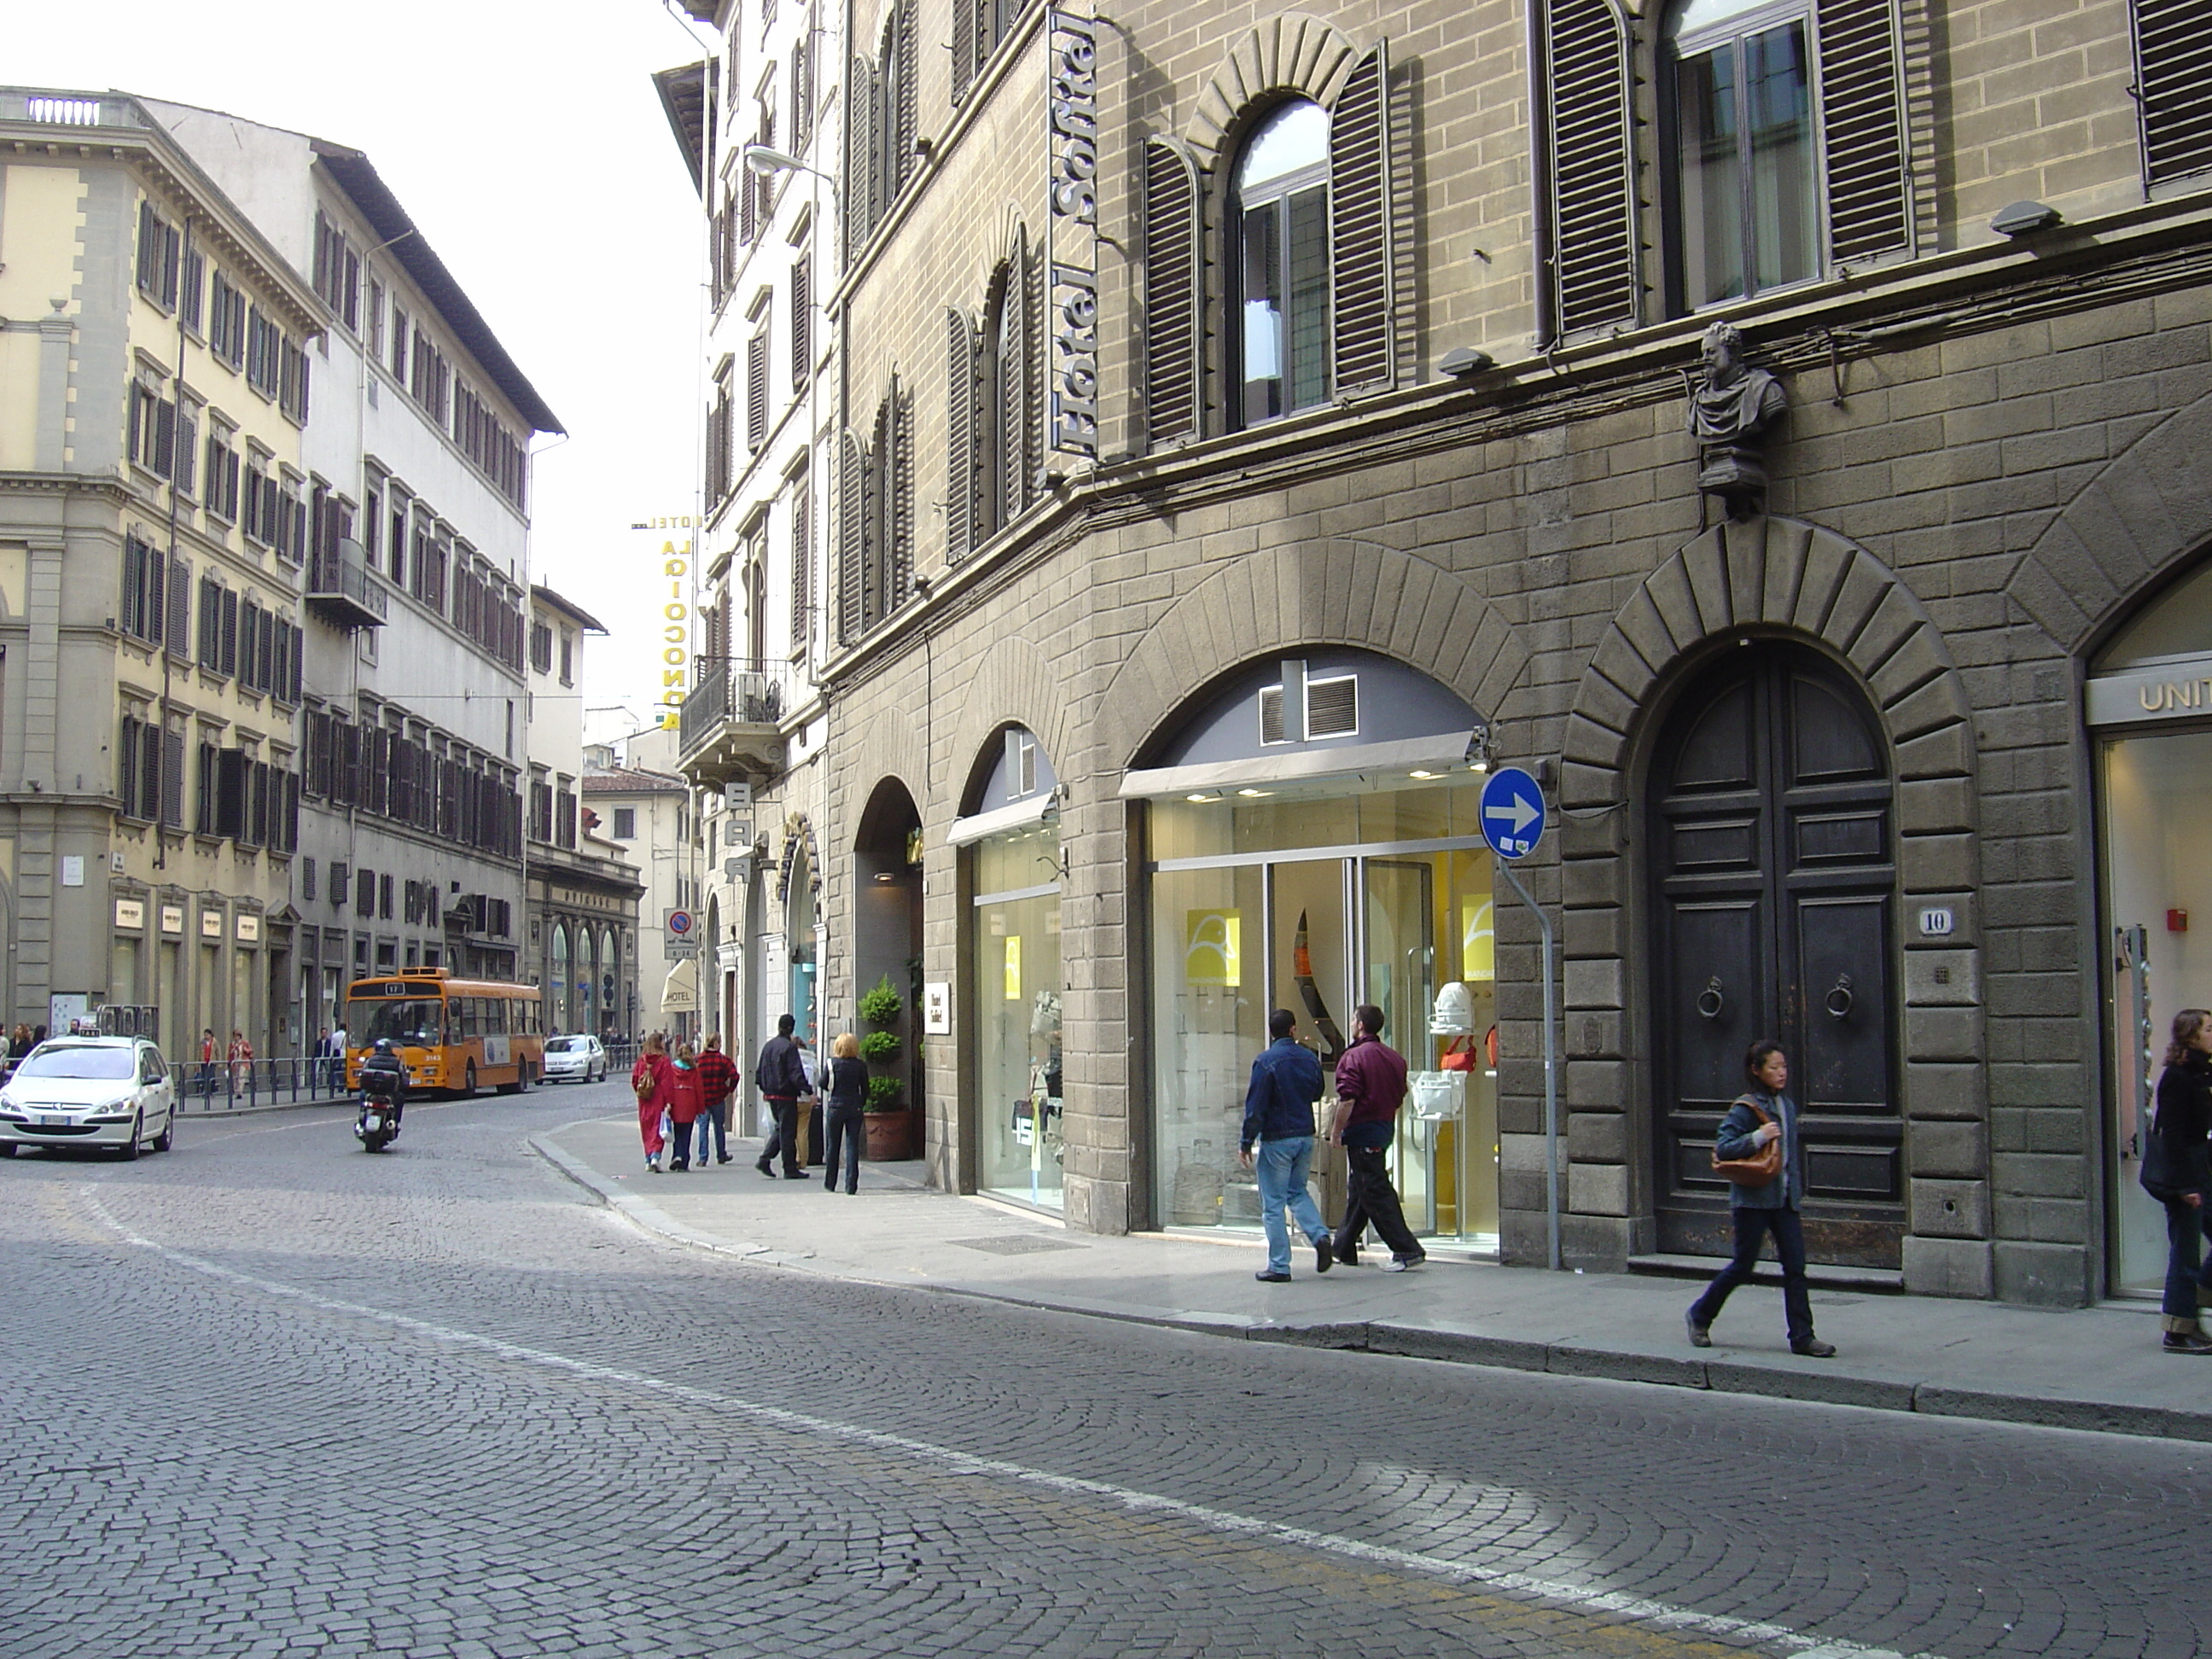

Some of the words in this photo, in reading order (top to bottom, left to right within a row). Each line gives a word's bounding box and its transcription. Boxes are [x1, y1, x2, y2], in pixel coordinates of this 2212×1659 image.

[1051, 14, 1097, 225] Sofitel
[1052, 270, 1098, 452] Hotel
[1926, 913, 1945, 930] 10
[667, 992, 690, 1001] HOTEL
